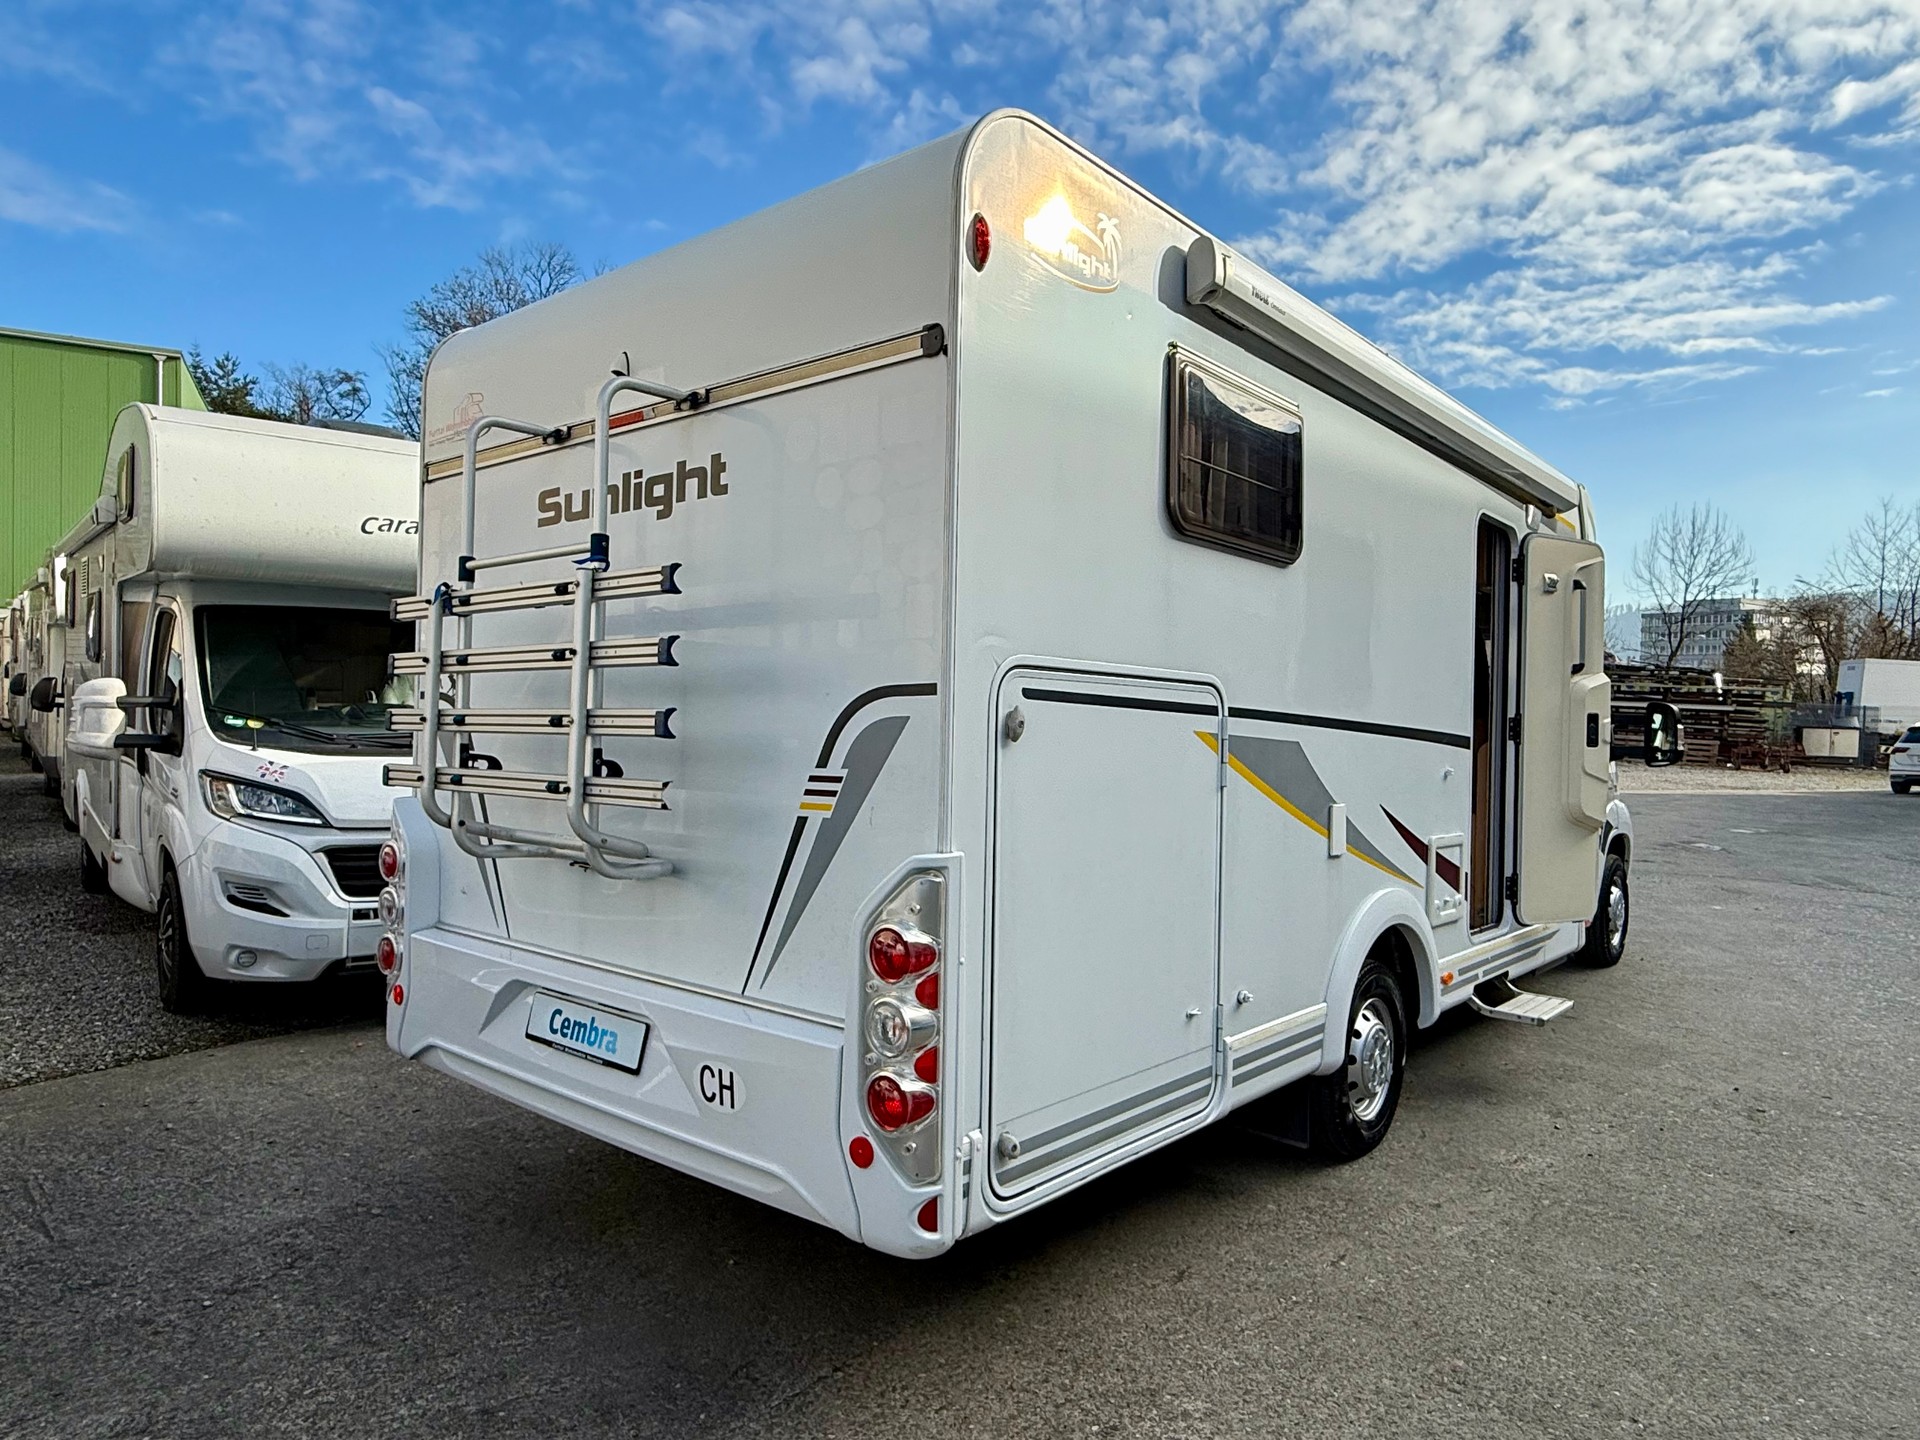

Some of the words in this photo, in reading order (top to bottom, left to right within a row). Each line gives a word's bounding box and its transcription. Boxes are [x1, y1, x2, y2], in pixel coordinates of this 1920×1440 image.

[1056, 238, 1111, 281] light
[360, 516, 419, 535] Cara
[548, 1008, 618, 1055] Cembra
[699, 1064, 735, 1110] CH
